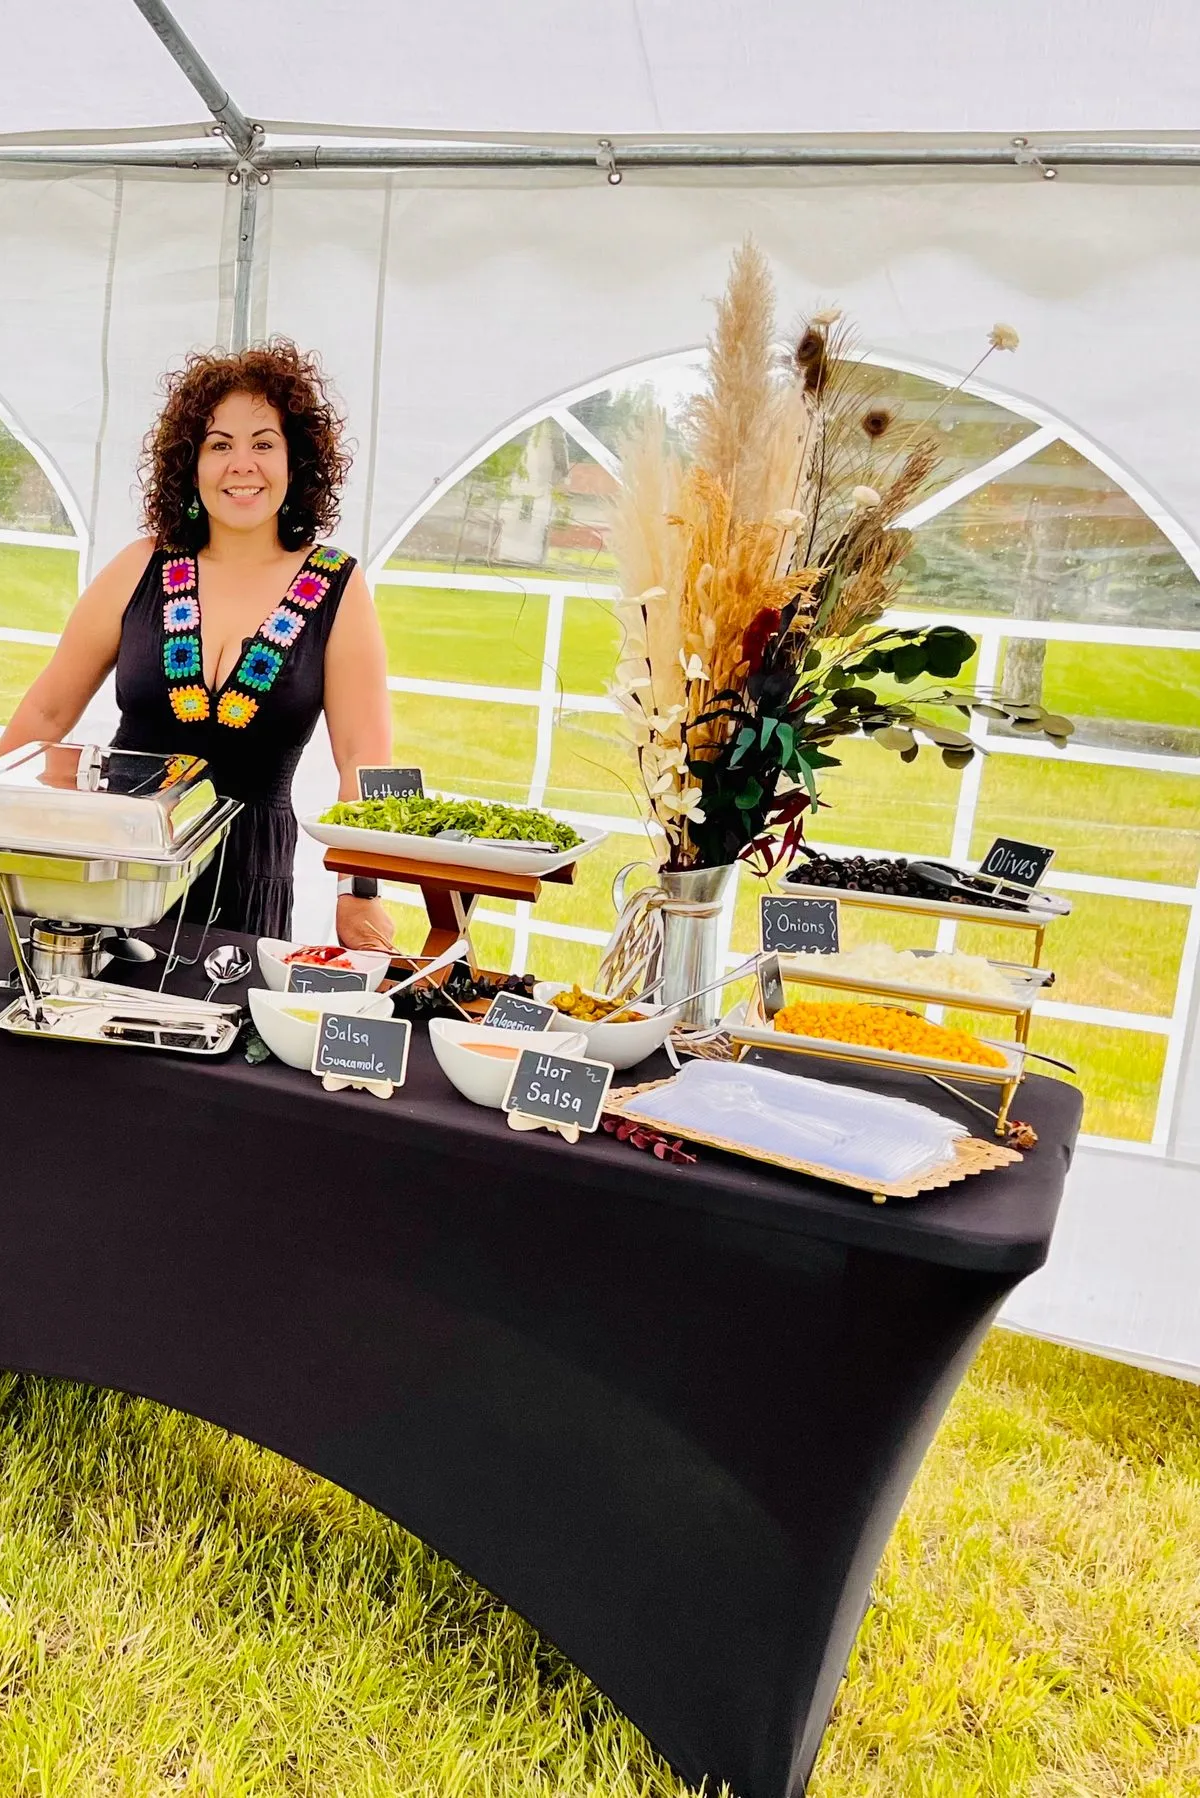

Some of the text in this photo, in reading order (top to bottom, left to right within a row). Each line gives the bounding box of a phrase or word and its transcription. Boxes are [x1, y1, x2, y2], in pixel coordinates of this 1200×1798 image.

[364, 781, 415, 798] Lettuce
[987, 847, 1038, 879] Olives
[777, 913, 825, 935] Onions
[325, 1016, 369, 1047] Salsa
[320, 1044, 386, 1074] Guacamole
[526, 1081, 582, 1112] Salsa
